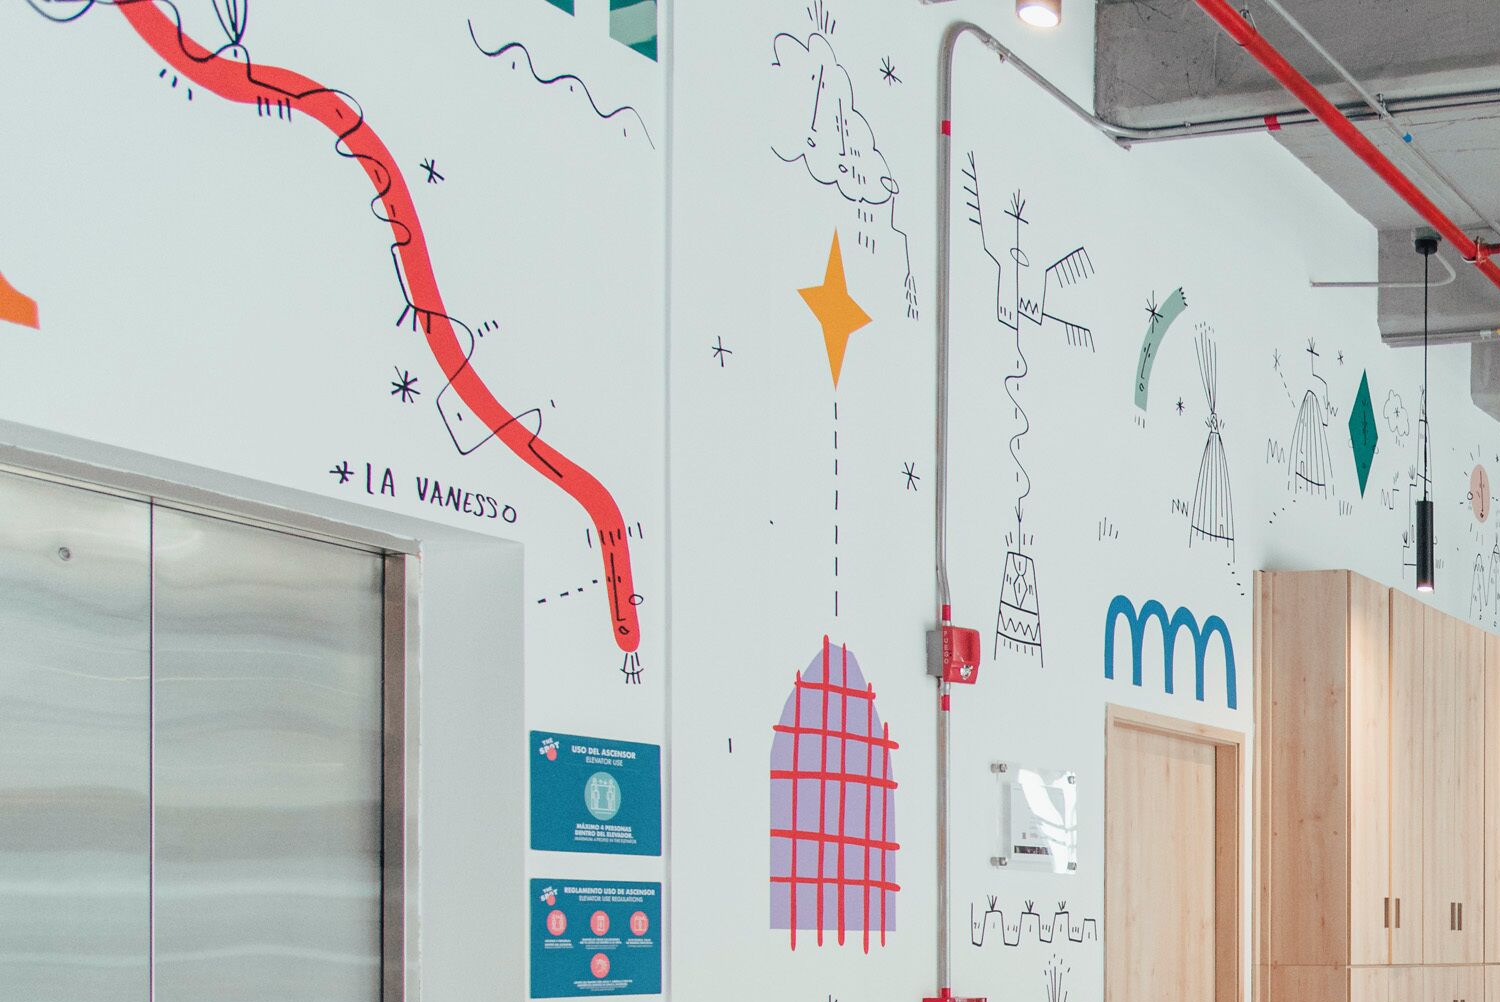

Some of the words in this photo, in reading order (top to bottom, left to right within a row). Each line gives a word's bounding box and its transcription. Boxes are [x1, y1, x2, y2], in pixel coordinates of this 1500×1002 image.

[366, 462, 396, 497] LA
[571, 745, 587, 754] USO
[588, 747, 601, 756] DEL
[601, 748, 636, 760] ASCENSOR
[586, 756, 612, 766] ELEVATOR
[612, 759, 624, 767] USE
[564, 886, 603, 895] REGLAMENTO
[603, 887, 617, 895] USO
[625, 888, 656, 896] ASCENSOR
